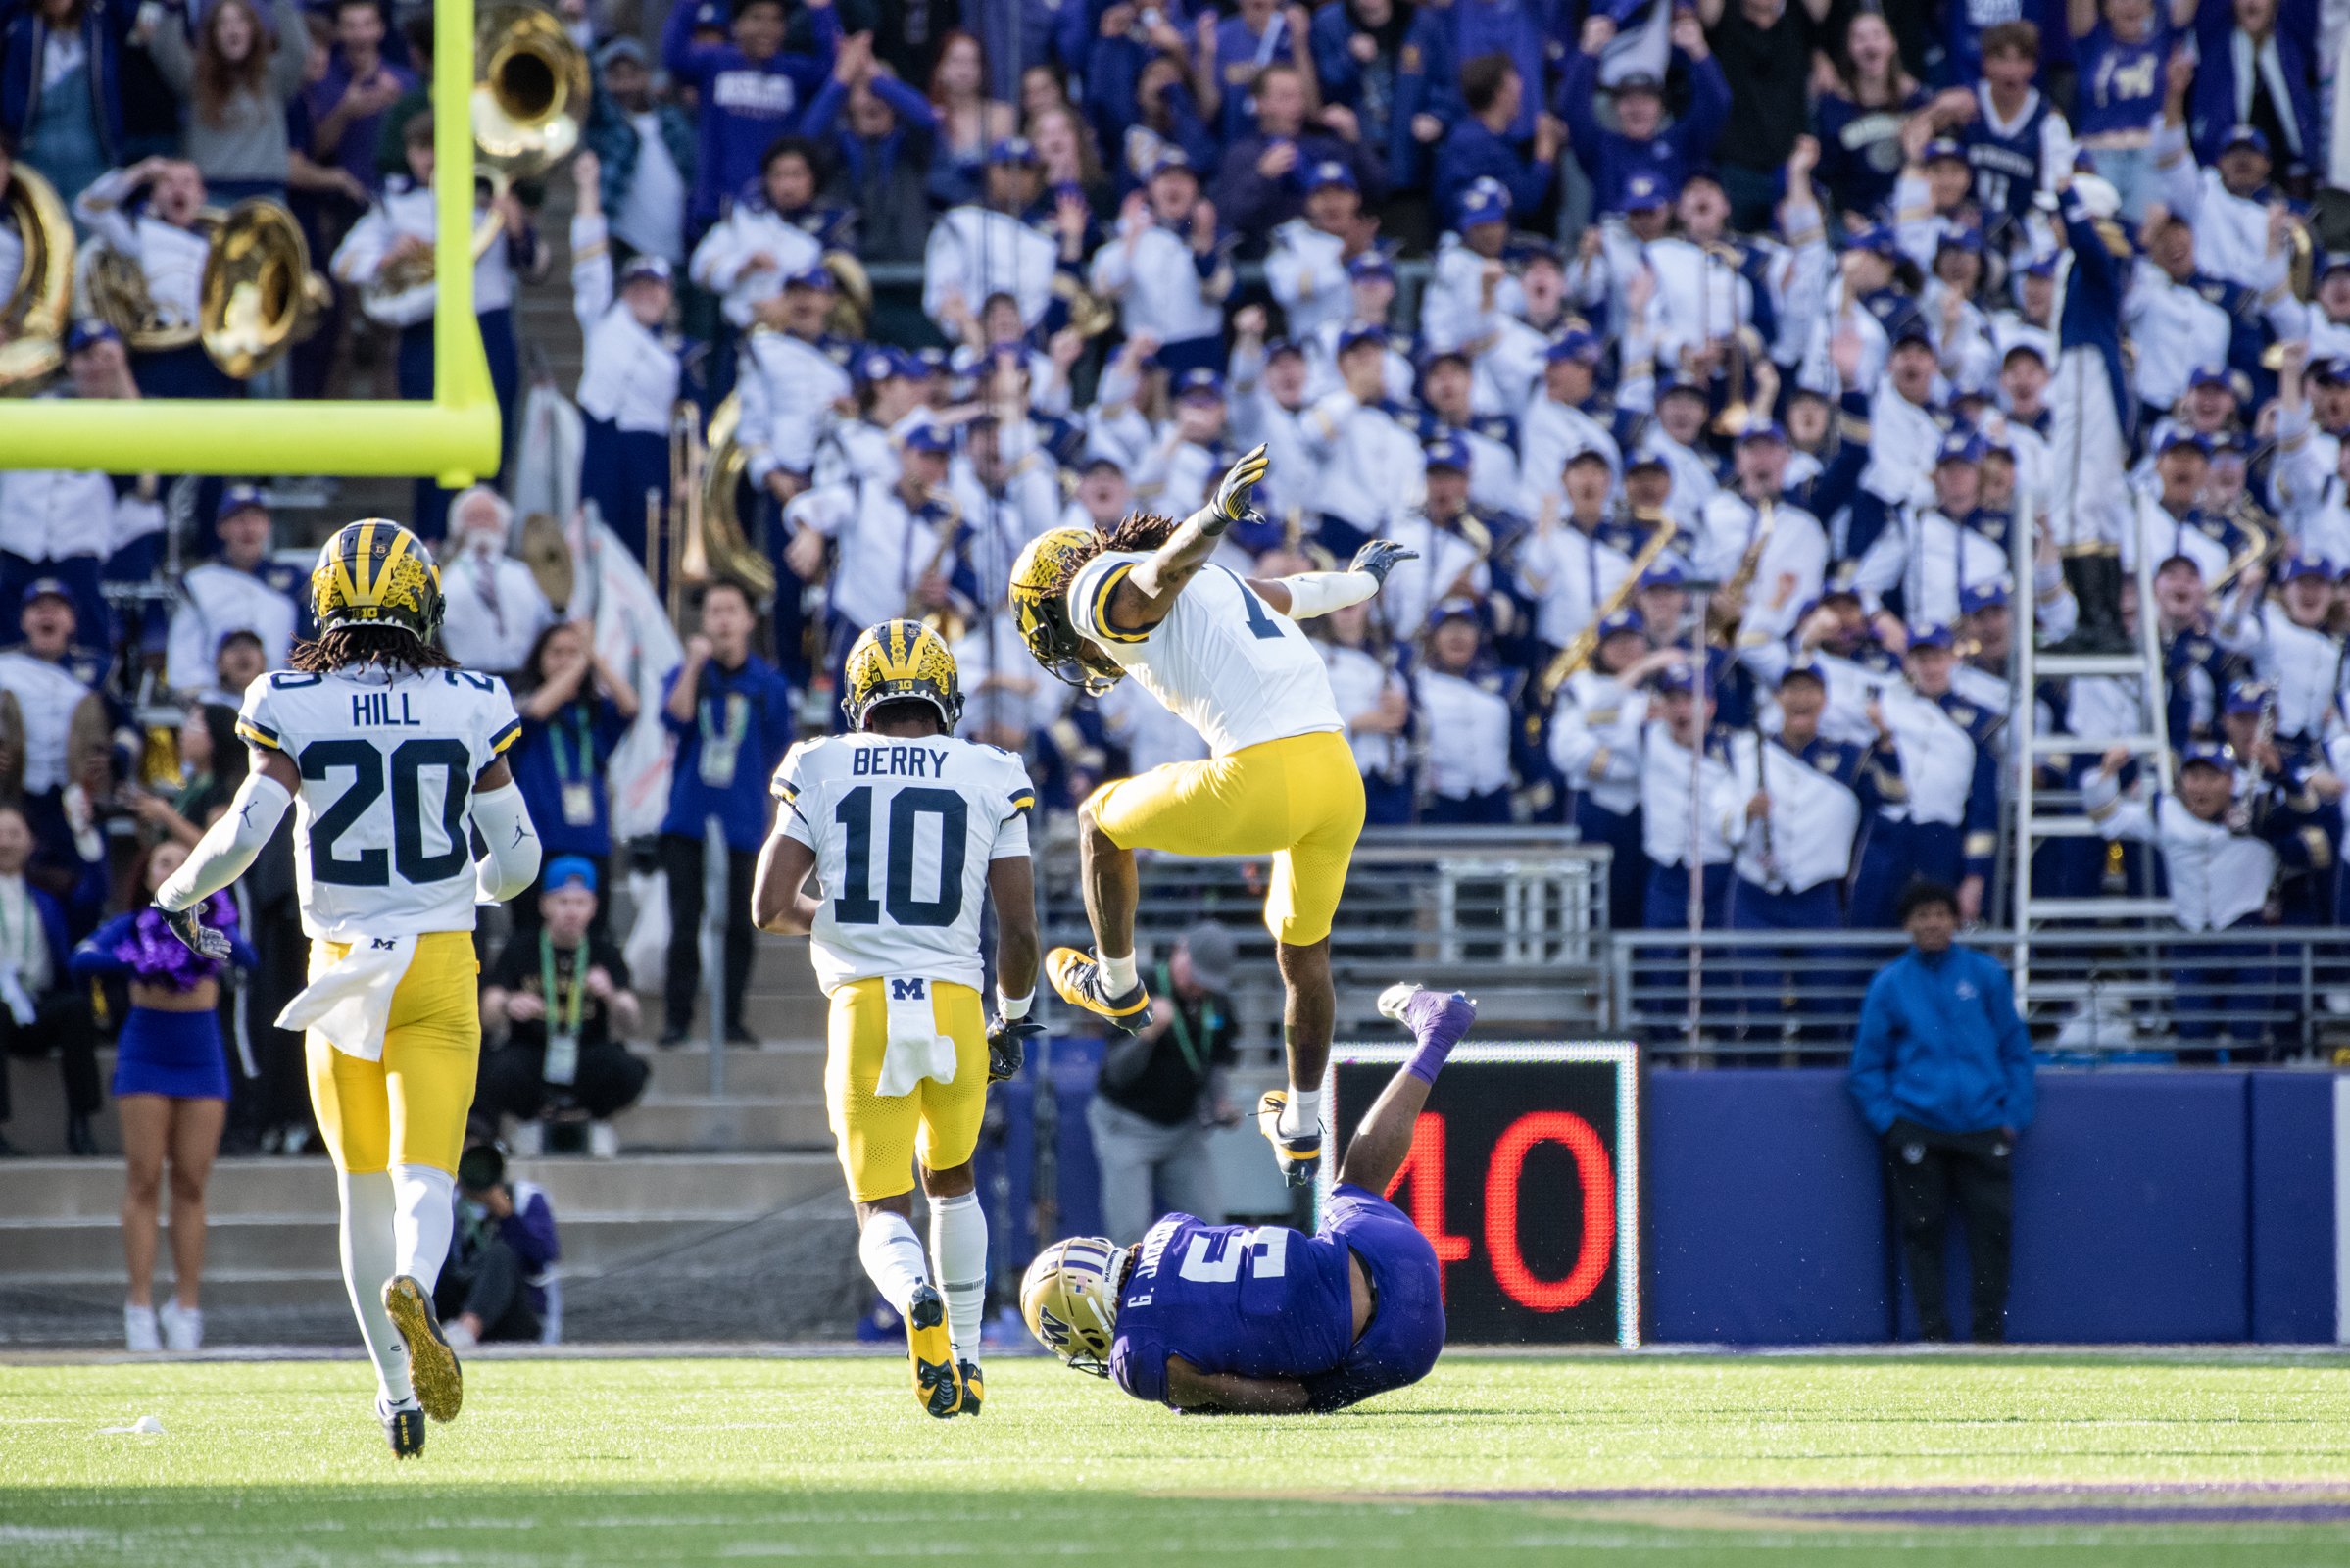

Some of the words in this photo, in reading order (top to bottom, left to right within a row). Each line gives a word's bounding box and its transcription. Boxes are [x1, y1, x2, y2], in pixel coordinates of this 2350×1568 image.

[352, 692, 421, 727] HILL
[852, 746, 950, 779] BERRY
[298, 738, 471, 887] 20
[834, 785, 968, 928] 10
[370, 937, 396, 951] M
[891, 978, 925, 1001] M
[1382, 1109, 1616, 1313] 40
[1179, 1226, 1289, 1283] 5
[1039, 1303, 1071, 1347] W
